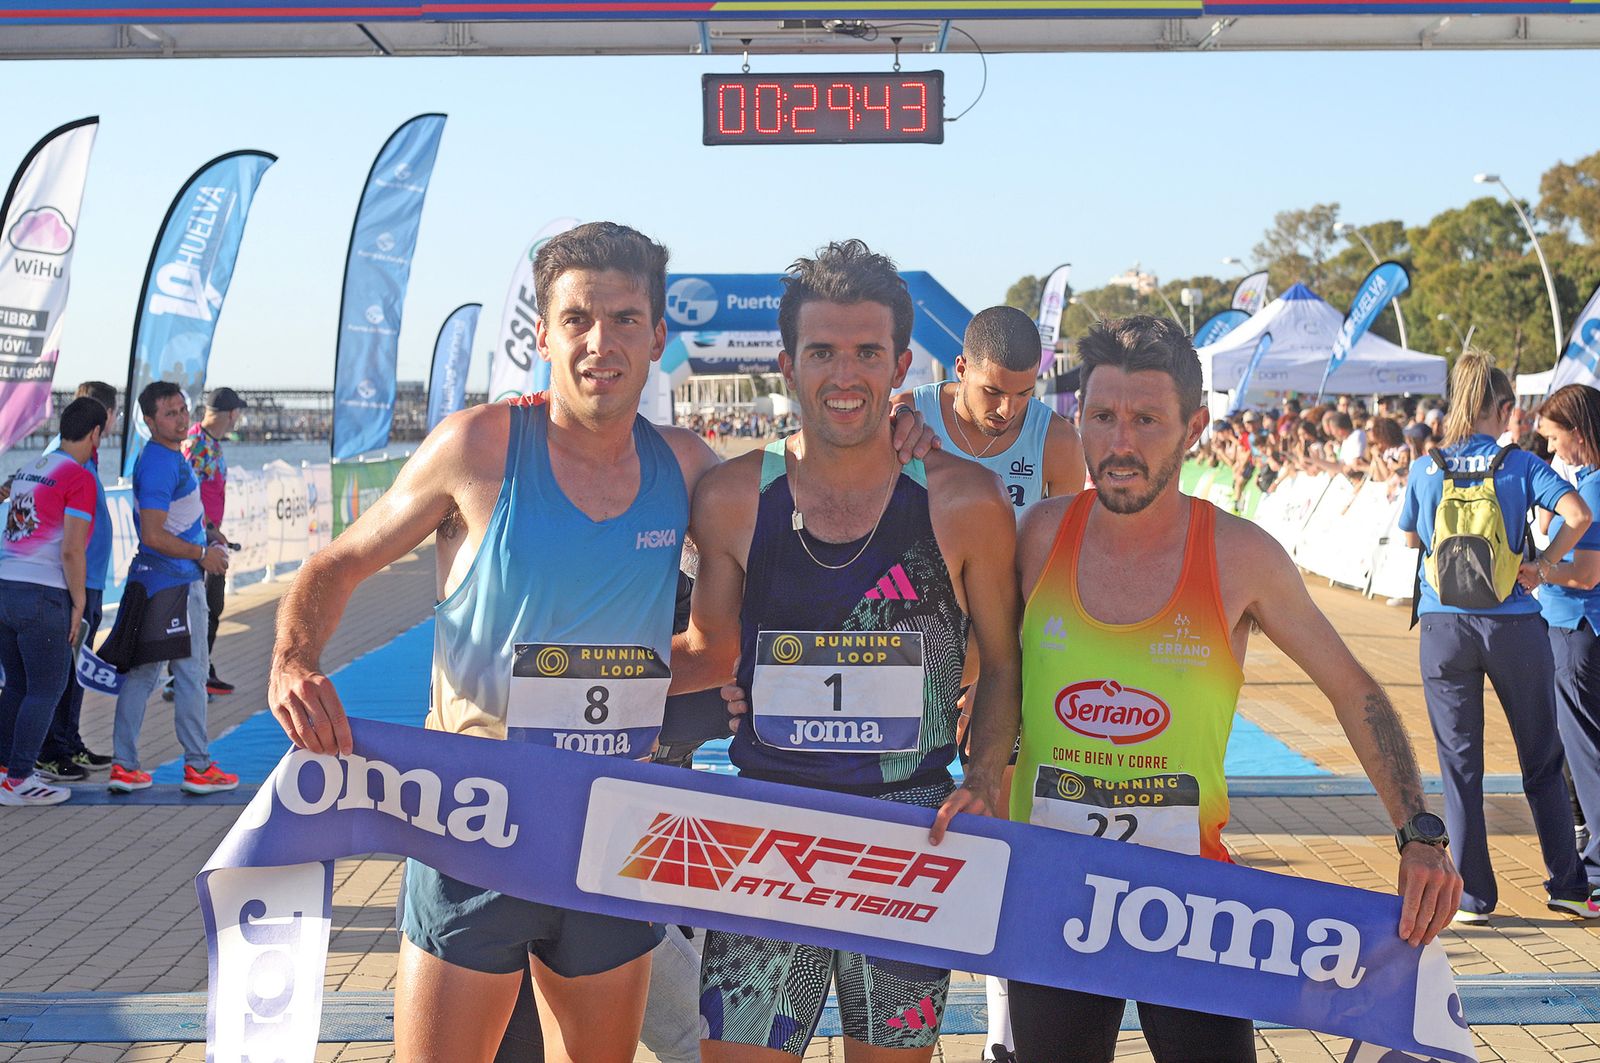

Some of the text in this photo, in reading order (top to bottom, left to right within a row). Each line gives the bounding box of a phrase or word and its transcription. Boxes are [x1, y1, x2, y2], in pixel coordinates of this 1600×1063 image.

[718, 82, 926, 135] 00:29:43
[174, 185, 226, 269] HUELVA
[14, 257, 64, 279] WiHu
[1009, 456, 1035, 477] als
[635, 528, 677, 550] HOKA
[816, 635, 902, 648] RUNNING
[1149, 643, 1211, 658] SERRANO
[580, 648, 655, 661] RUNNING
[837, 651, 888, 664] LOOP
[600, 664, 645, 677] LOOP
[823, 672, 843, 712] 1
[583, 685, 610, 725] 8
[1063, 693, 1161, 728] Serrano
[789, 719, 884, 746] Joma
[1052, 747, 1169, 770] COME BIEN Y CORRE
[1093, 777, 1179, 790] RUNNING
[1113, 793, 1165, 806] LOOP
[747, 827, 967, 895] RFEA
[730, 875, 940, 924] ATLETISMO
[1062, 873, 1367, 990] Joma
